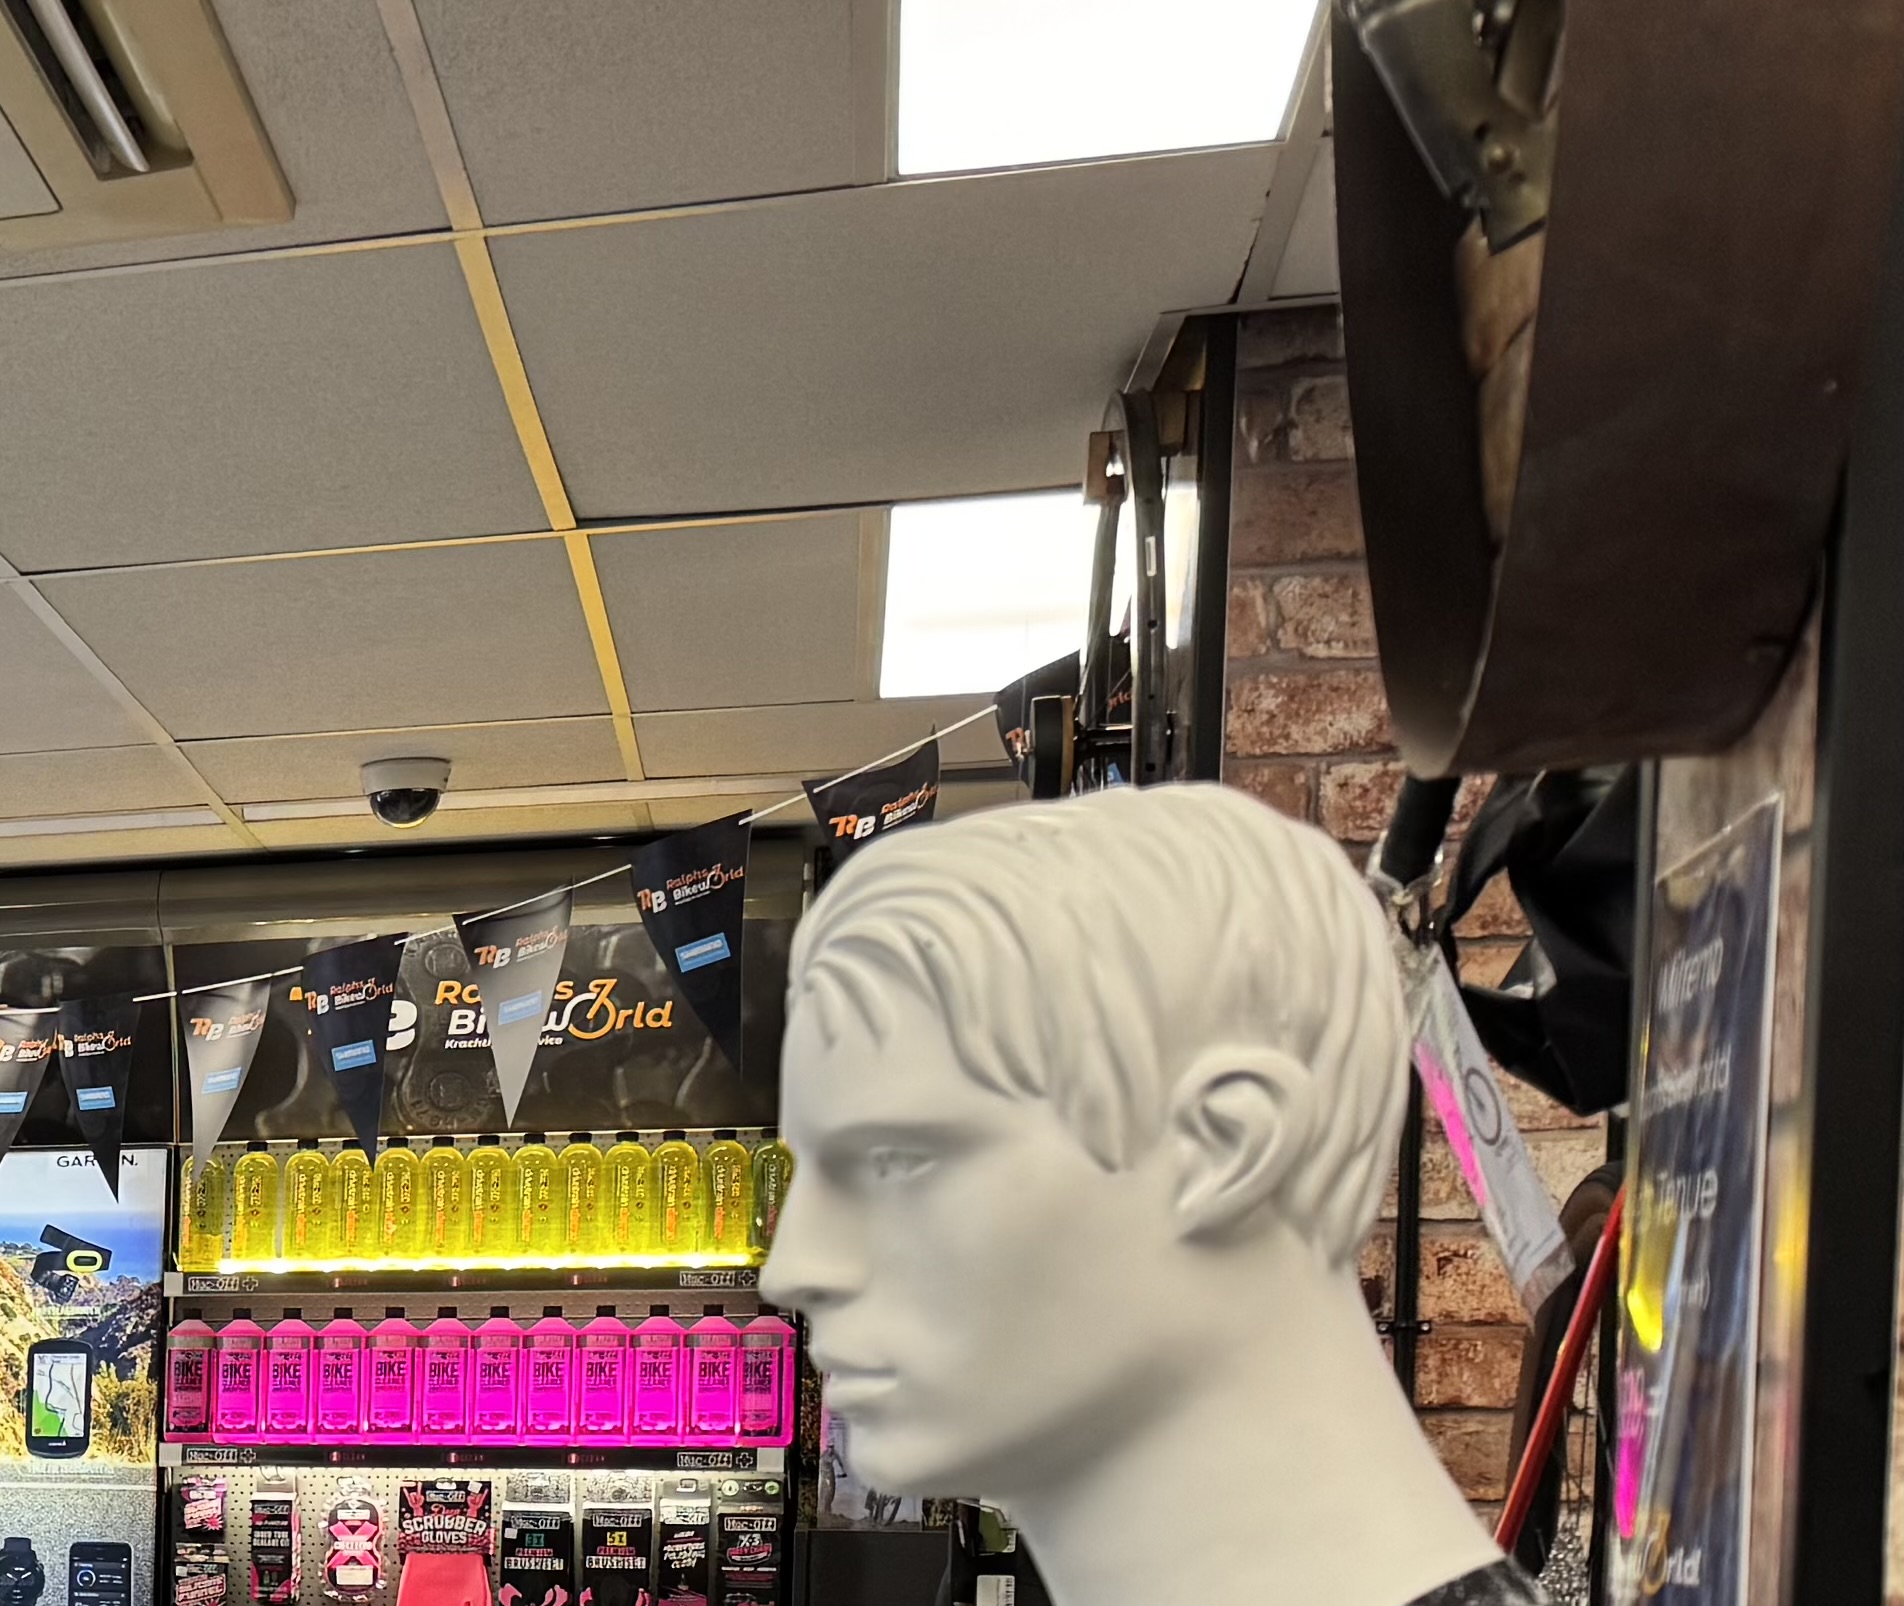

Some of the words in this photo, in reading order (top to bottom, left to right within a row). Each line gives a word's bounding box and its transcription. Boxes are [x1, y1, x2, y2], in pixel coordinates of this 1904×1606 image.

[56, 1154, 139, 1169] GARN.
[174, 1362, 202, 1379] BIKE
[223, 1363, 250, 1379] BIKE
[273, 1363, 301, 1379] BIKE
[323, 1363, 352, 1379] BIKE
[376, 1361, 406, 1377] BIKE
[429, 1361, 459, 1377] BIKE
[480, 1362, 511, 1378] BIKE
[533, 1362, 565, 1378] BIKE
[586, 1362, 618, 1378] BIKE
[640, 1362, 672, 1378] BIKE
[699, 1361, 731, 1377] BIKE
[744, 1361, 772, 1376] BIKE
[402, 1515, 487, 1535] SCRUBBER
[420, 1529, 468, 1544] GLOVES
